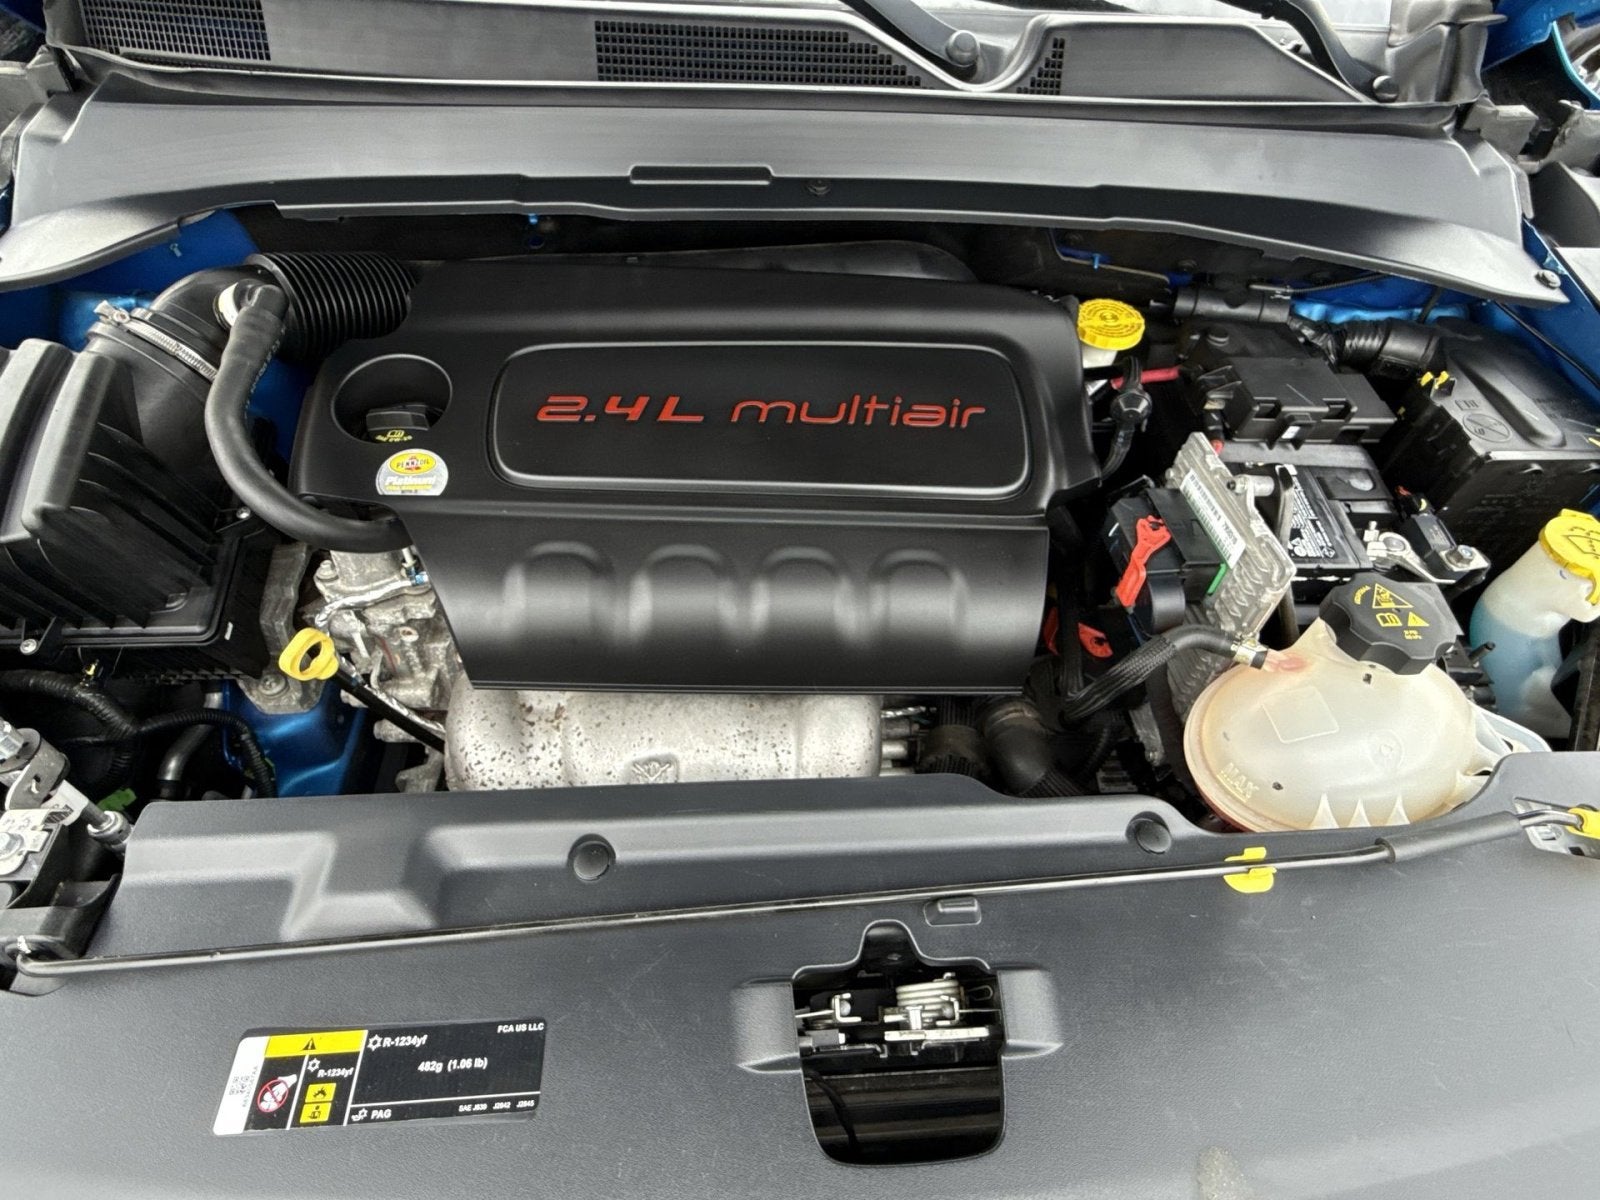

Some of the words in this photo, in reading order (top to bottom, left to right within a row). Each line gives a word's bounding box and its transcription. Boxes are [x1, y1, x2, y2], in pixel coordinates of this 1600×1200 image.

[536, 394, 704, 422] 2.4L
[730, 394, 986, 428] multiair
[396, 458, 430, 468] PENNZOIL
[497, 1024, 514, 1033] FCA
[515, 1023, 527, 1032] US
[528, 1022, 545, 1031] LLC
[382, 1034, 428, 1048] R-1234yf
[417, 1061, 443, 1073] 482g
[447, 1059, 472, 1072] (1.06
[473, 1057, 488, 1070] lb)
[317, 1067, 354, 1079] R-1234yf
[371, 1109, 392, 1120] PAG
